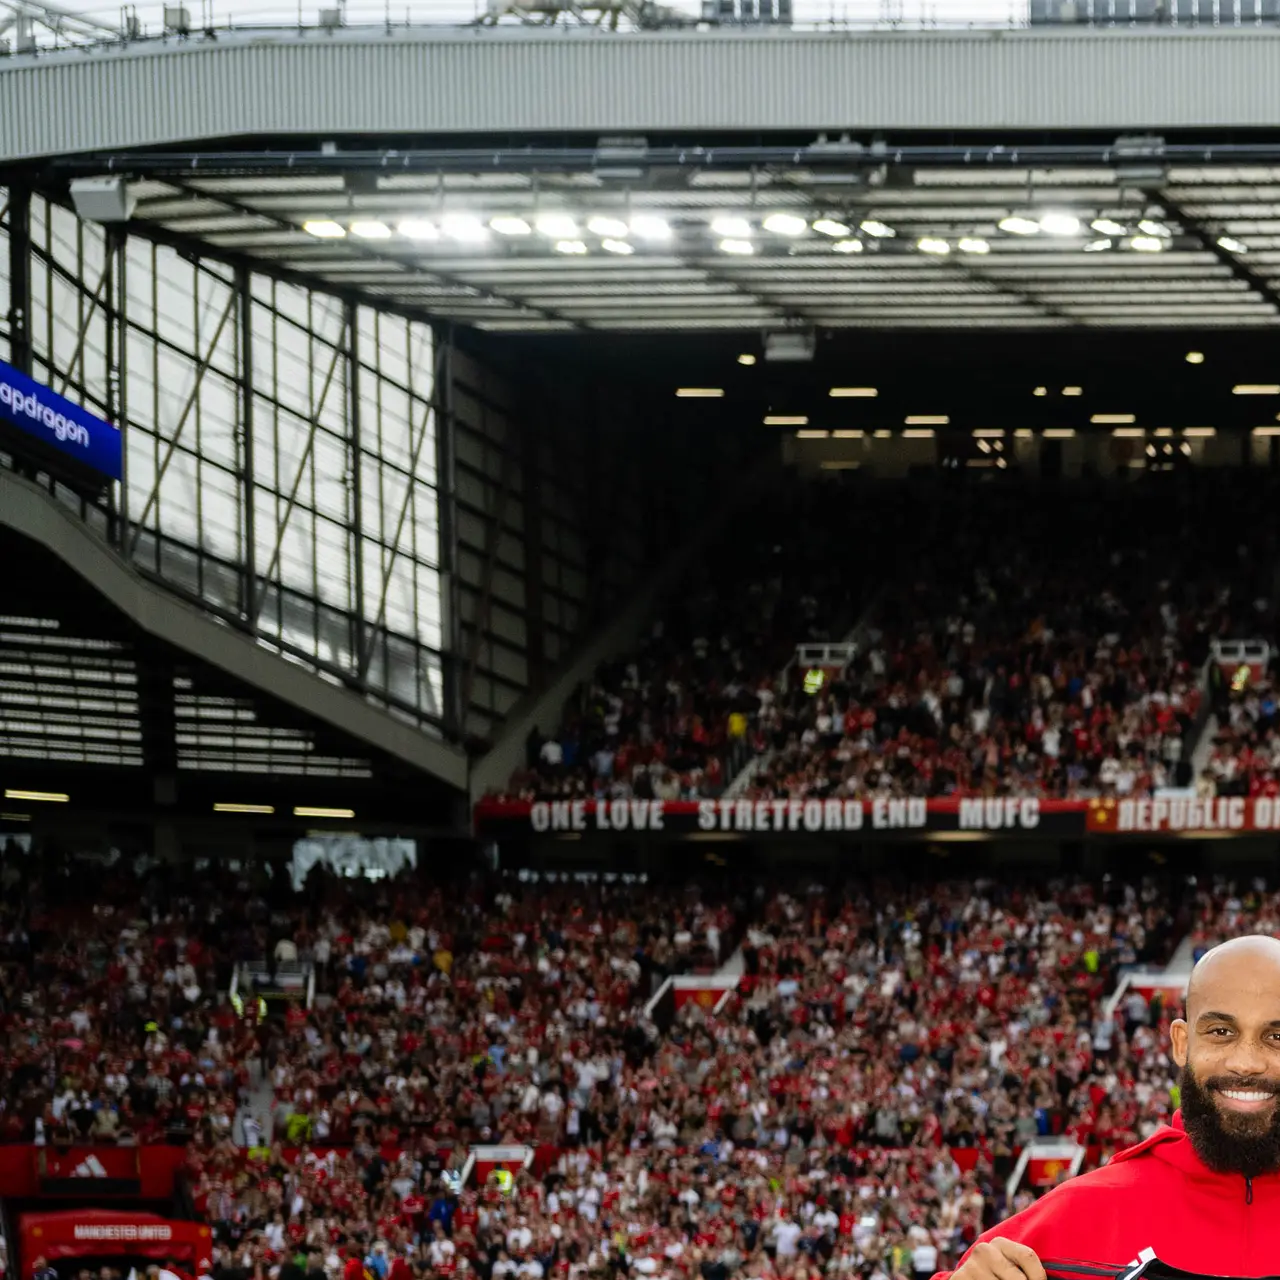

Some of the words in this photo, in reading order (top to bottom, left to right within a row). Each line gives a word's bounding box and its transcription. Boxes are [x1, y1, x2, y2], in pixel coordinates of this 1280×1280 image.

[0, 381, 90, 448] apdragon
[531, 798, 588, 832] ONE
[596, 798, 665, 831] LOVE
[698, 798, 864, 831] STRETFORD
[872, 797, 928, 830] END
[958, 797, 1041, 830] MUFC
[74, 1225, 138, 1241] MANCHESTER
[139, 1225, 172, 1241] UNITED
